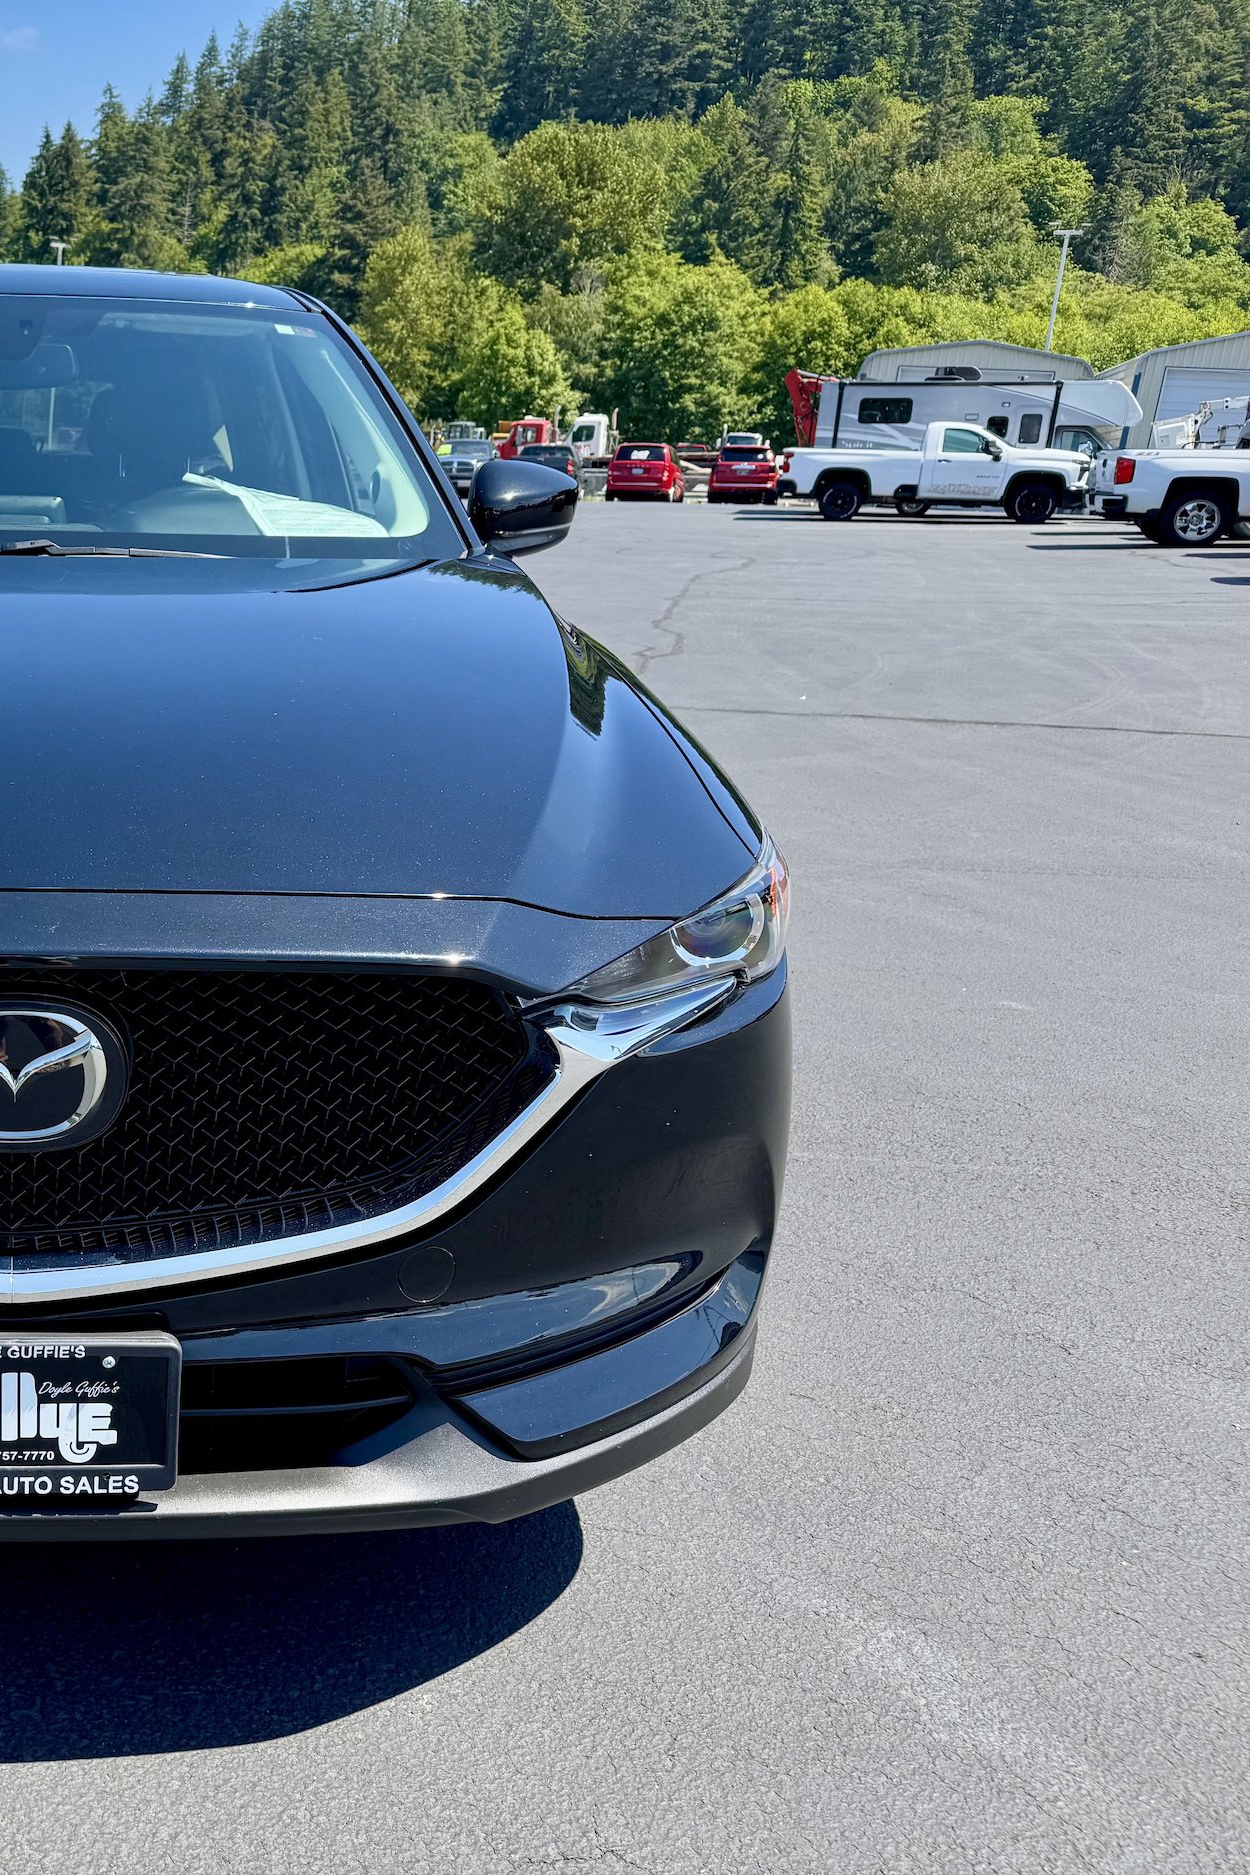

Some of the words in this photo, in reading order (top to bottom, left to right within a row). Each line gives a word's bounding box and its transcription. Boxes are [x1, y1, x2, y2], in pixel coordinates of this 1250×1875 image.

[7, 1345, 86, 1358] GUFFIE'S
[38, 1381, 73, 1398] Doyle
[75, 1381, 120, 1398] Guffie's
[59, 1474, 140, 1494] SALES
